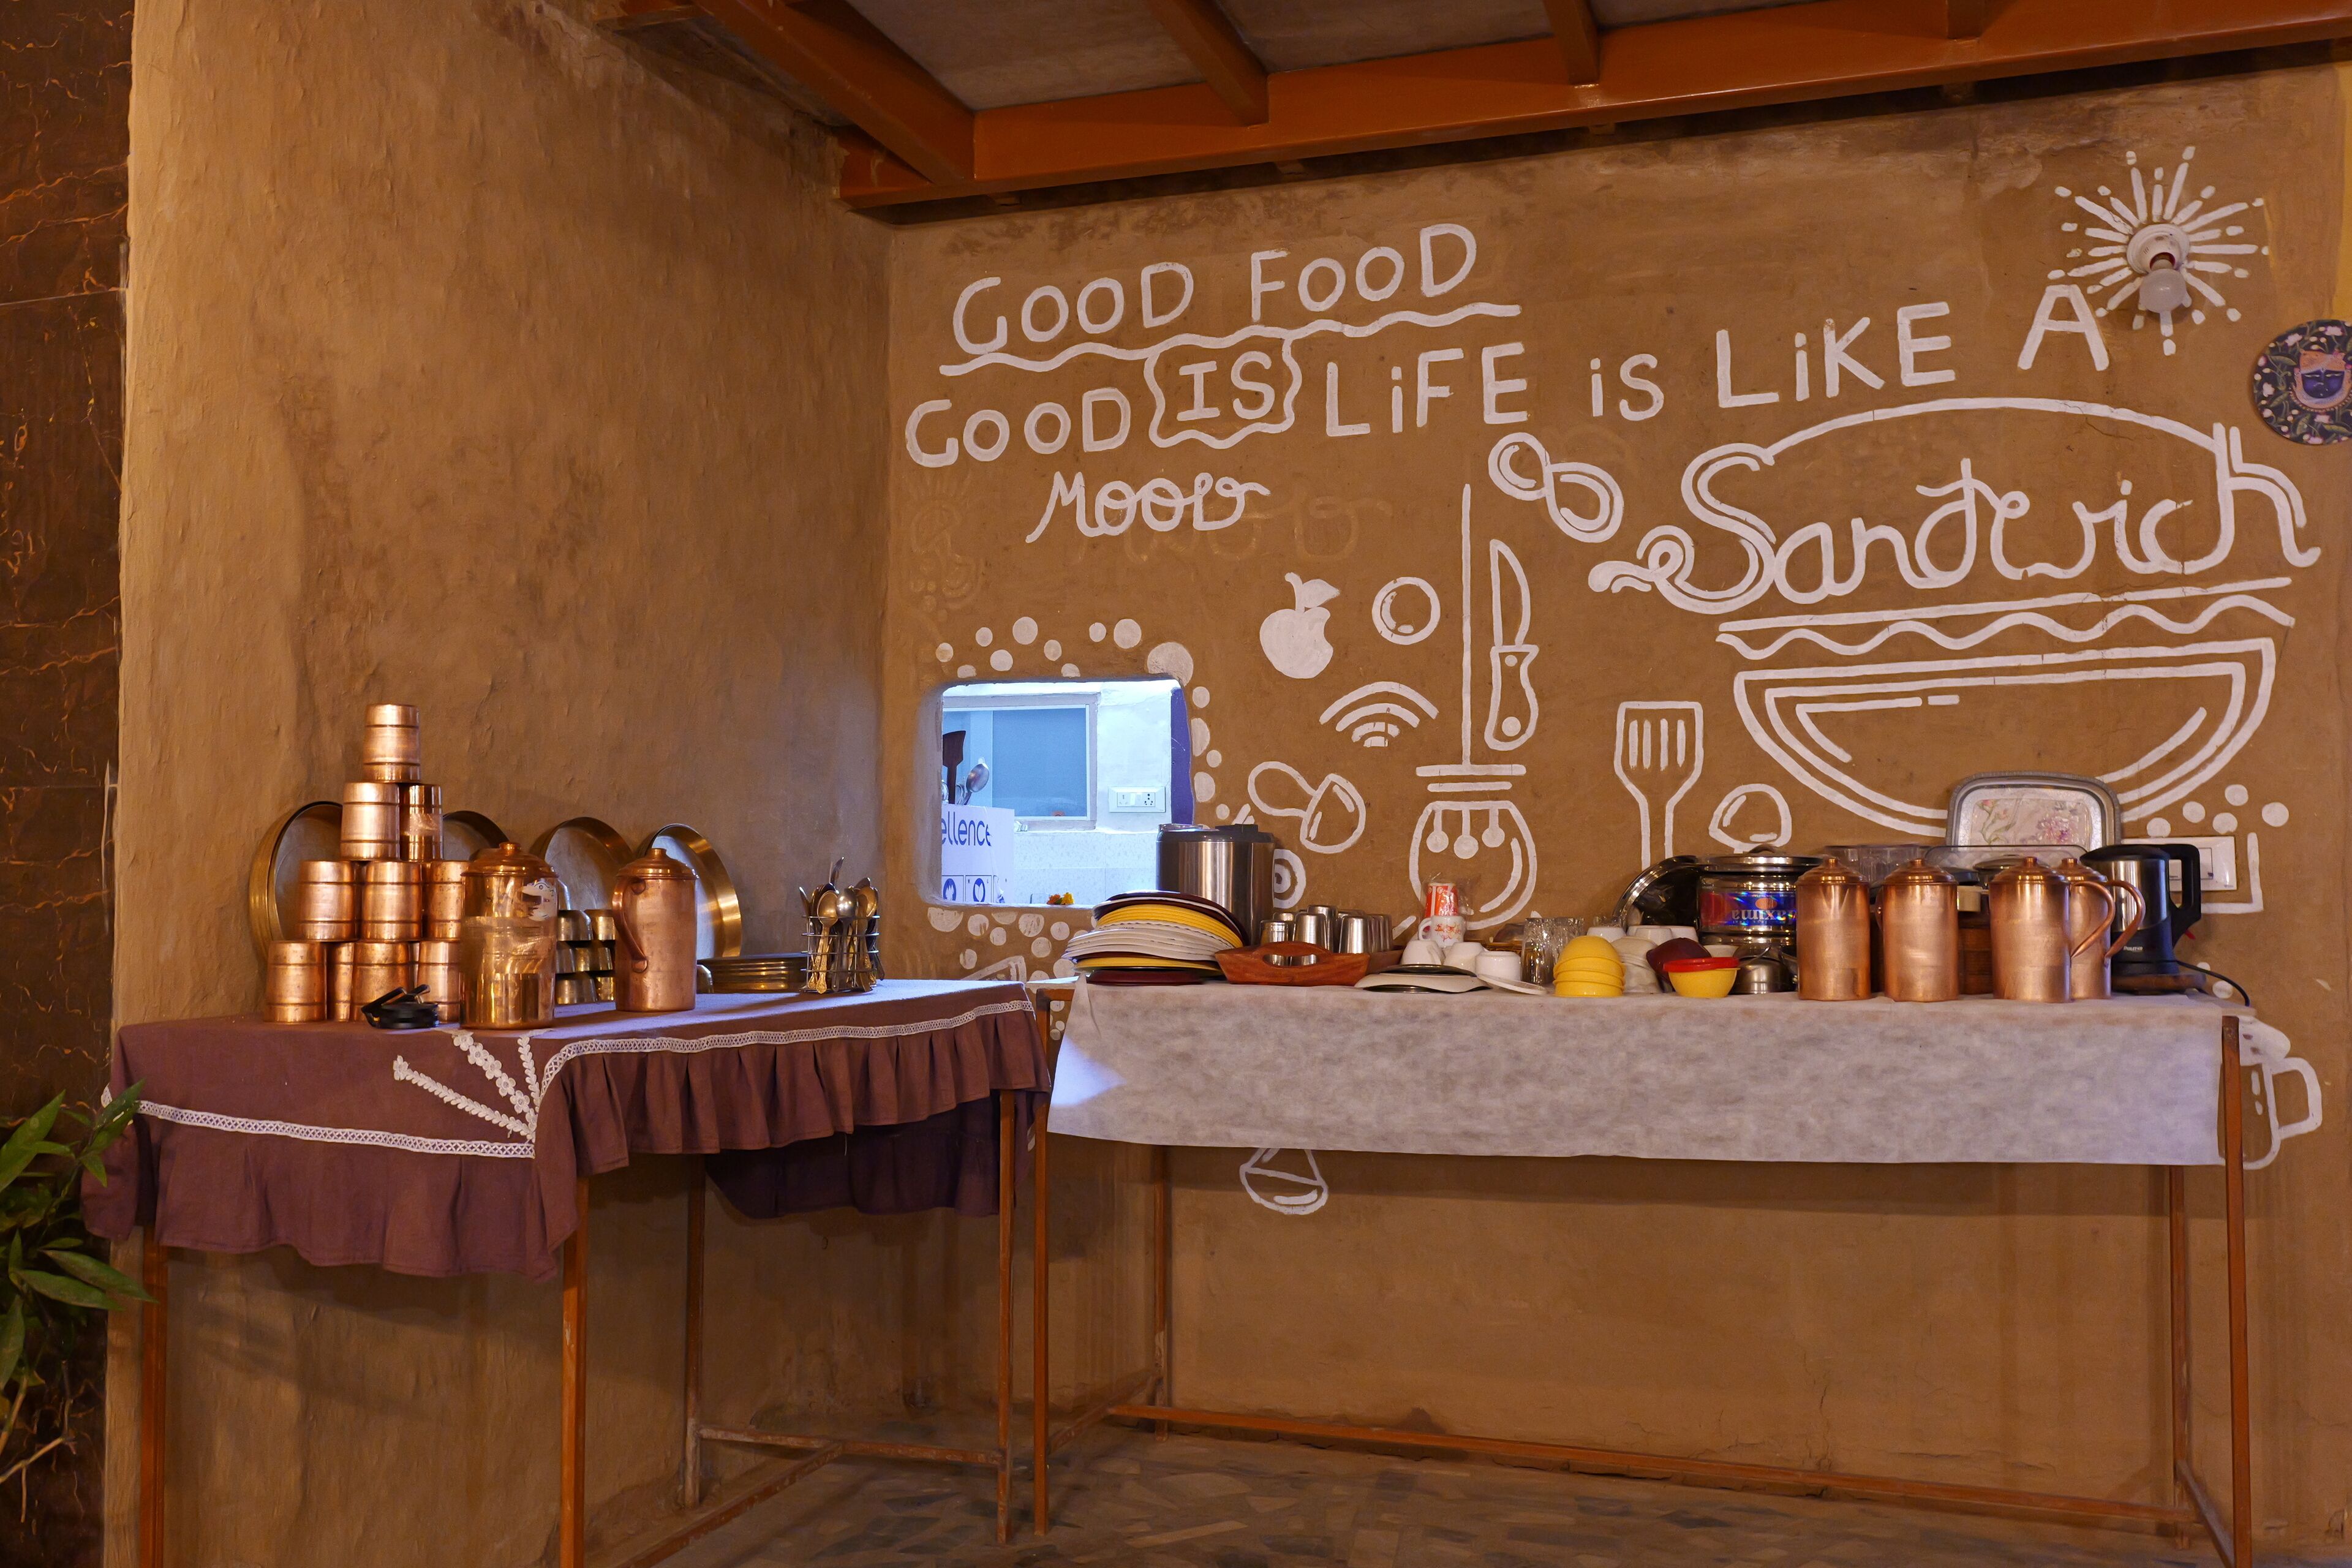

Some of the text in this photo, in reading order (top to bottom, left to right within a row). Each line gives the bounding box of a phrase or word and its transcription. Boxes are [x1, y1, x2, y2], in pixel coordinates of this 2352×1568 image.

[953, 223, 1477, 355] GOOD FOOD
[2017, 283, 2110, 371] A
[905, 388, 1131, 468] GOOD
[1177, 350, 1275, 421] IS
[1588, 422, 2321, 615] Sandwich
